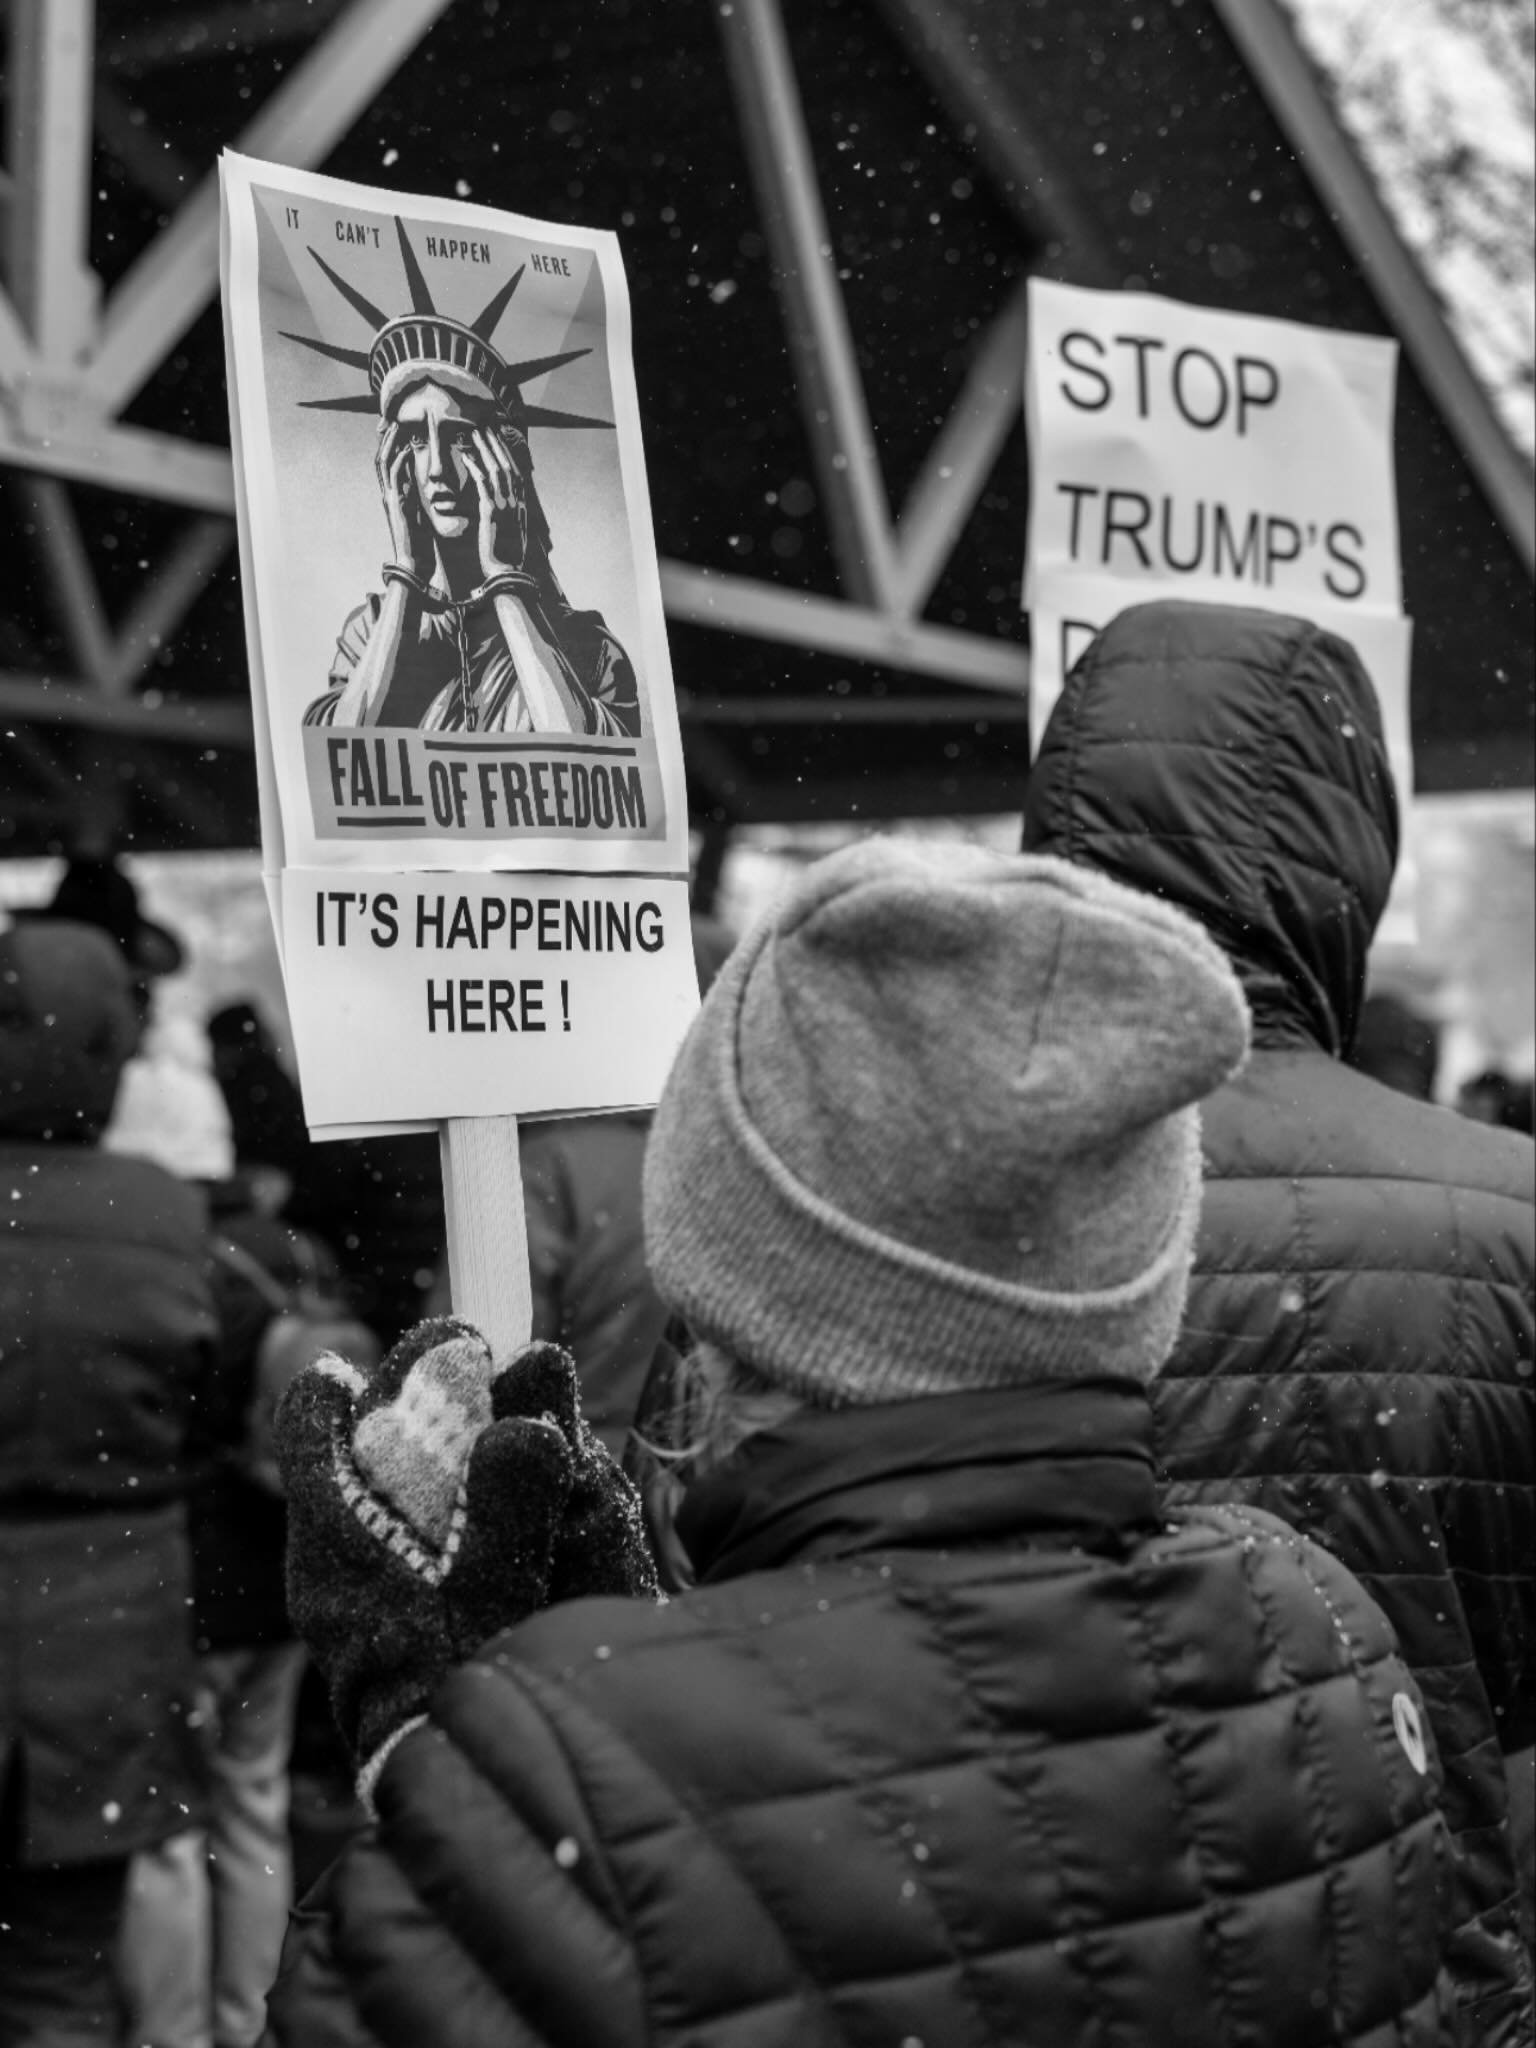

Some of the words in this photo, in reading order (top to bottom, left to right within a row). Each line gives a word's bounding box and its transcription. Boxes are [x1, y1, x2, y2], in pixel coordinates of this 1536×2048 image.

[286, 207, 300, 229] IT
[335, 220, 381, 249] CAN'T
[426, 236, 491, 264] HAPPEN
[531, 253, 571, 277] HERE
[1058, 330, 1281, 436] STOP
[1057, 483, 1368, 599] TRUMP'S
[327, 738, 424, 806] FALL
[428, 759, 468, 828] OF
[478, 761, 647, 829] FREEDOM
[316, 892, 399, 948] IT'S
[416, 895, 664, 953] HAPPENING
[426, 979, 546, 1032] HERE
